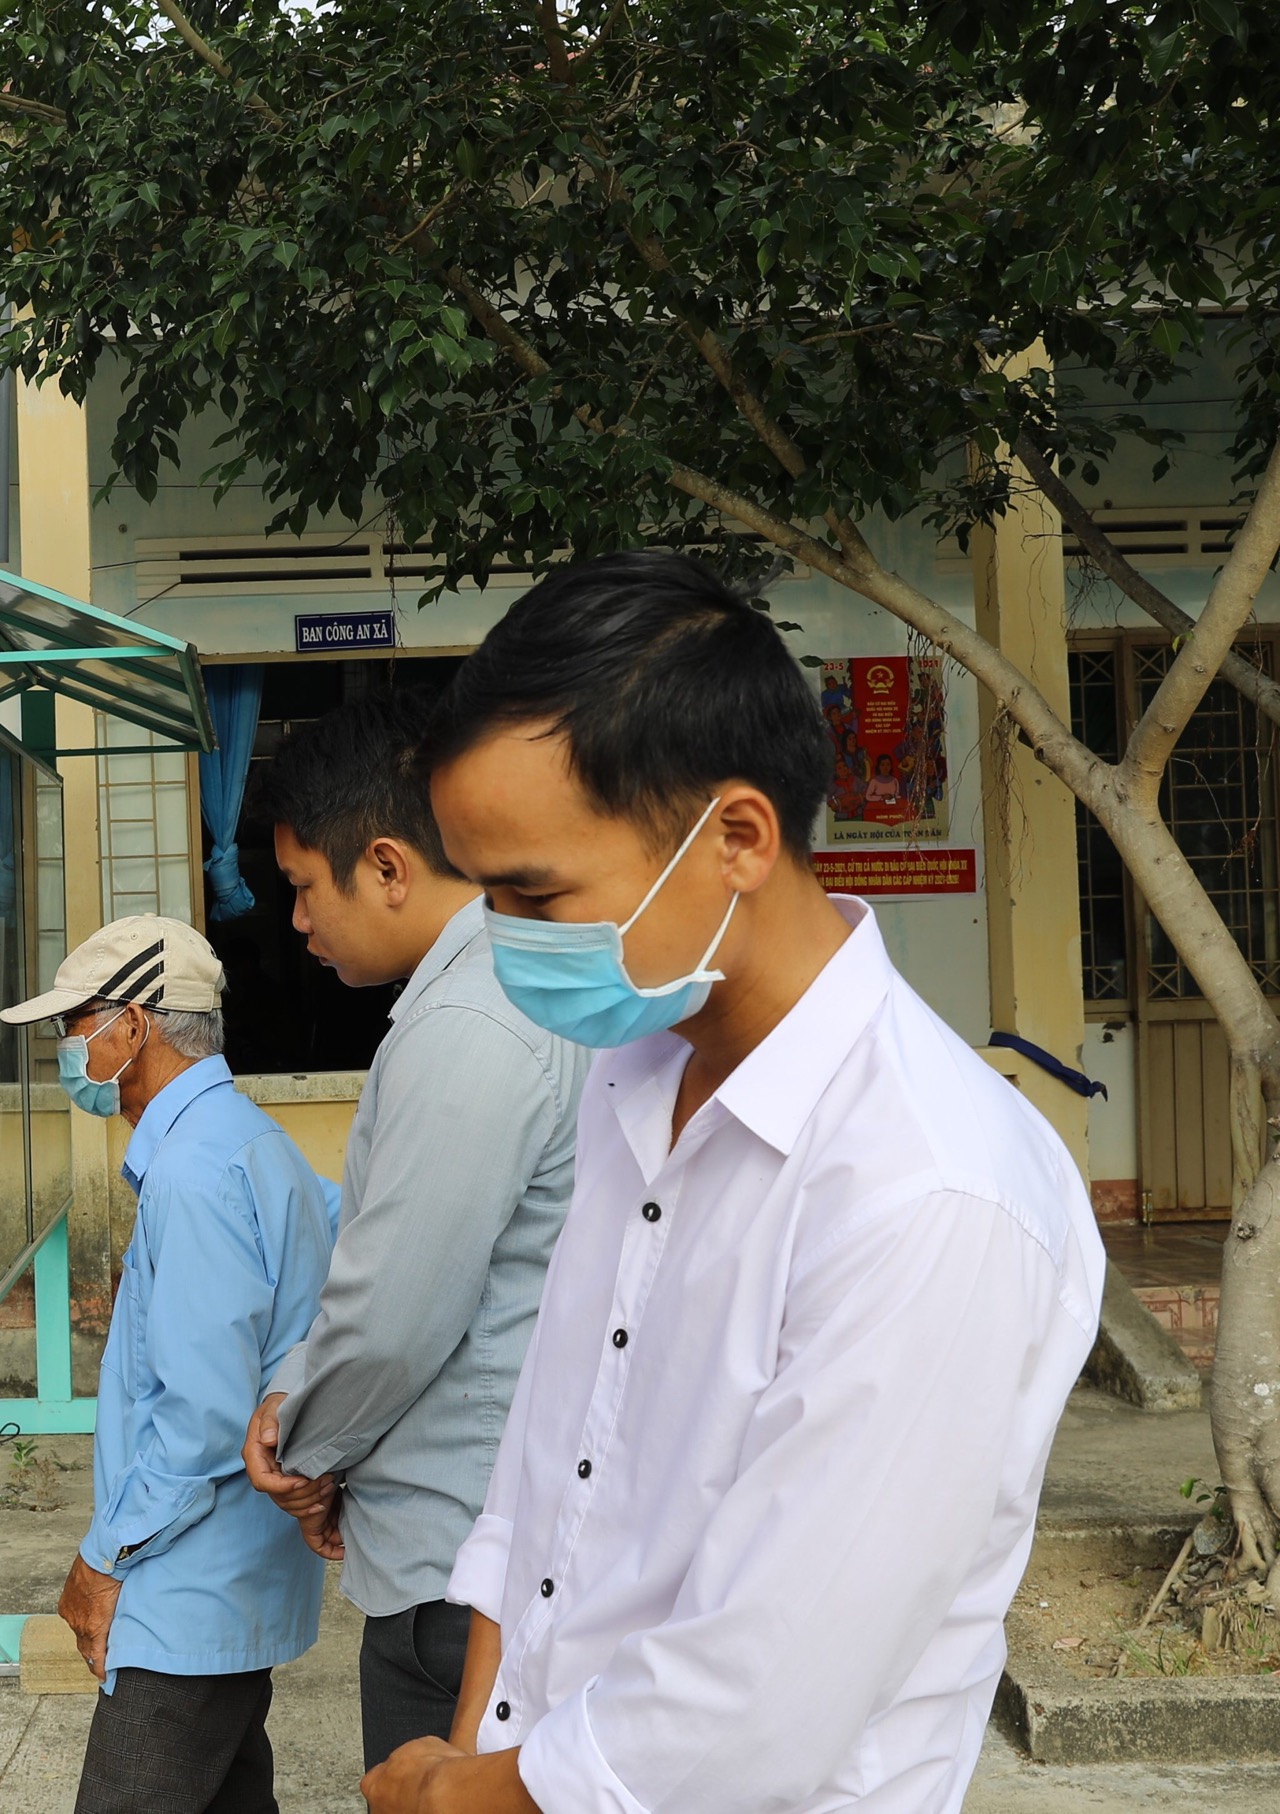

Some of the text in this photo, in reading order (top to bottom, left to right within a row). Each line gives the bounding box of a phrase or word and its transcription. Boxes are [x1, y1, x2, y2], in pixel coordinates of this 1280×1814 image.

[302, 619, 388, 642] BAN CÔNG AN XÃ
[834, 831, 845, 840] LÀ
[846, 830, 868, 840] NGÀY
[870, 830, 883, 840] HỘI
[885, 829, 900, 839] CỦA
